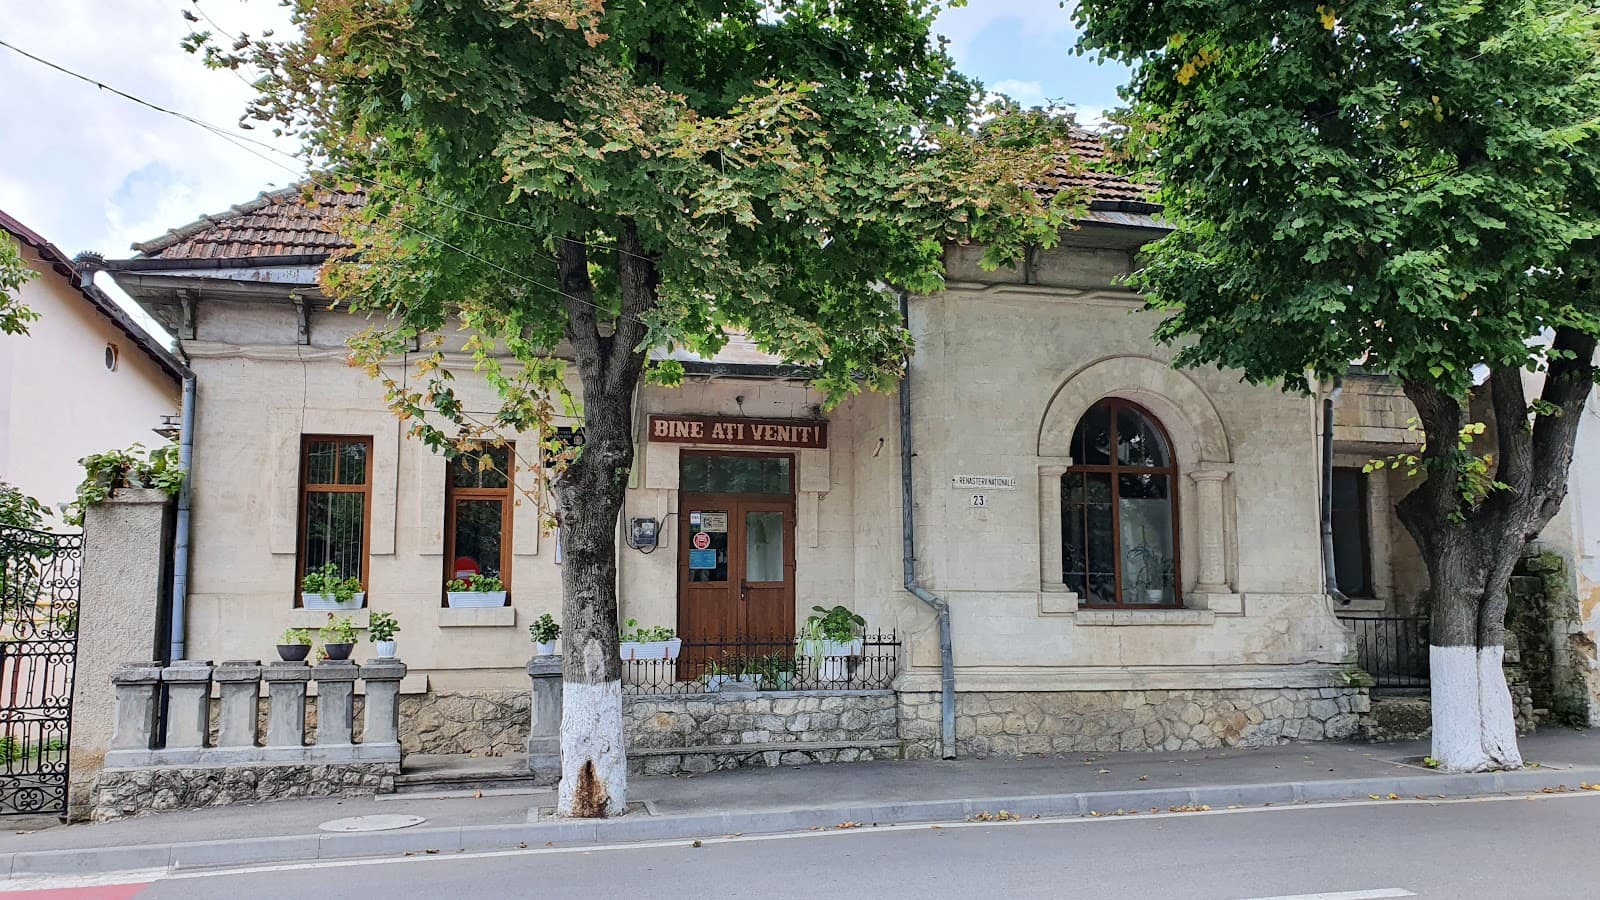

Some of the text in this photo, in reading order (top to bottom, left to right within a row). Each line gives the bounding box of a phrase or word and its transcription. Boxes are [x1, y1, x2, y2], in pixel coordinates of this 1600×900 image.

[654, 419, 704, 438] BINE
[750, 424, 820, 444] VENIT!
[973, 495, 984, 506] 23
